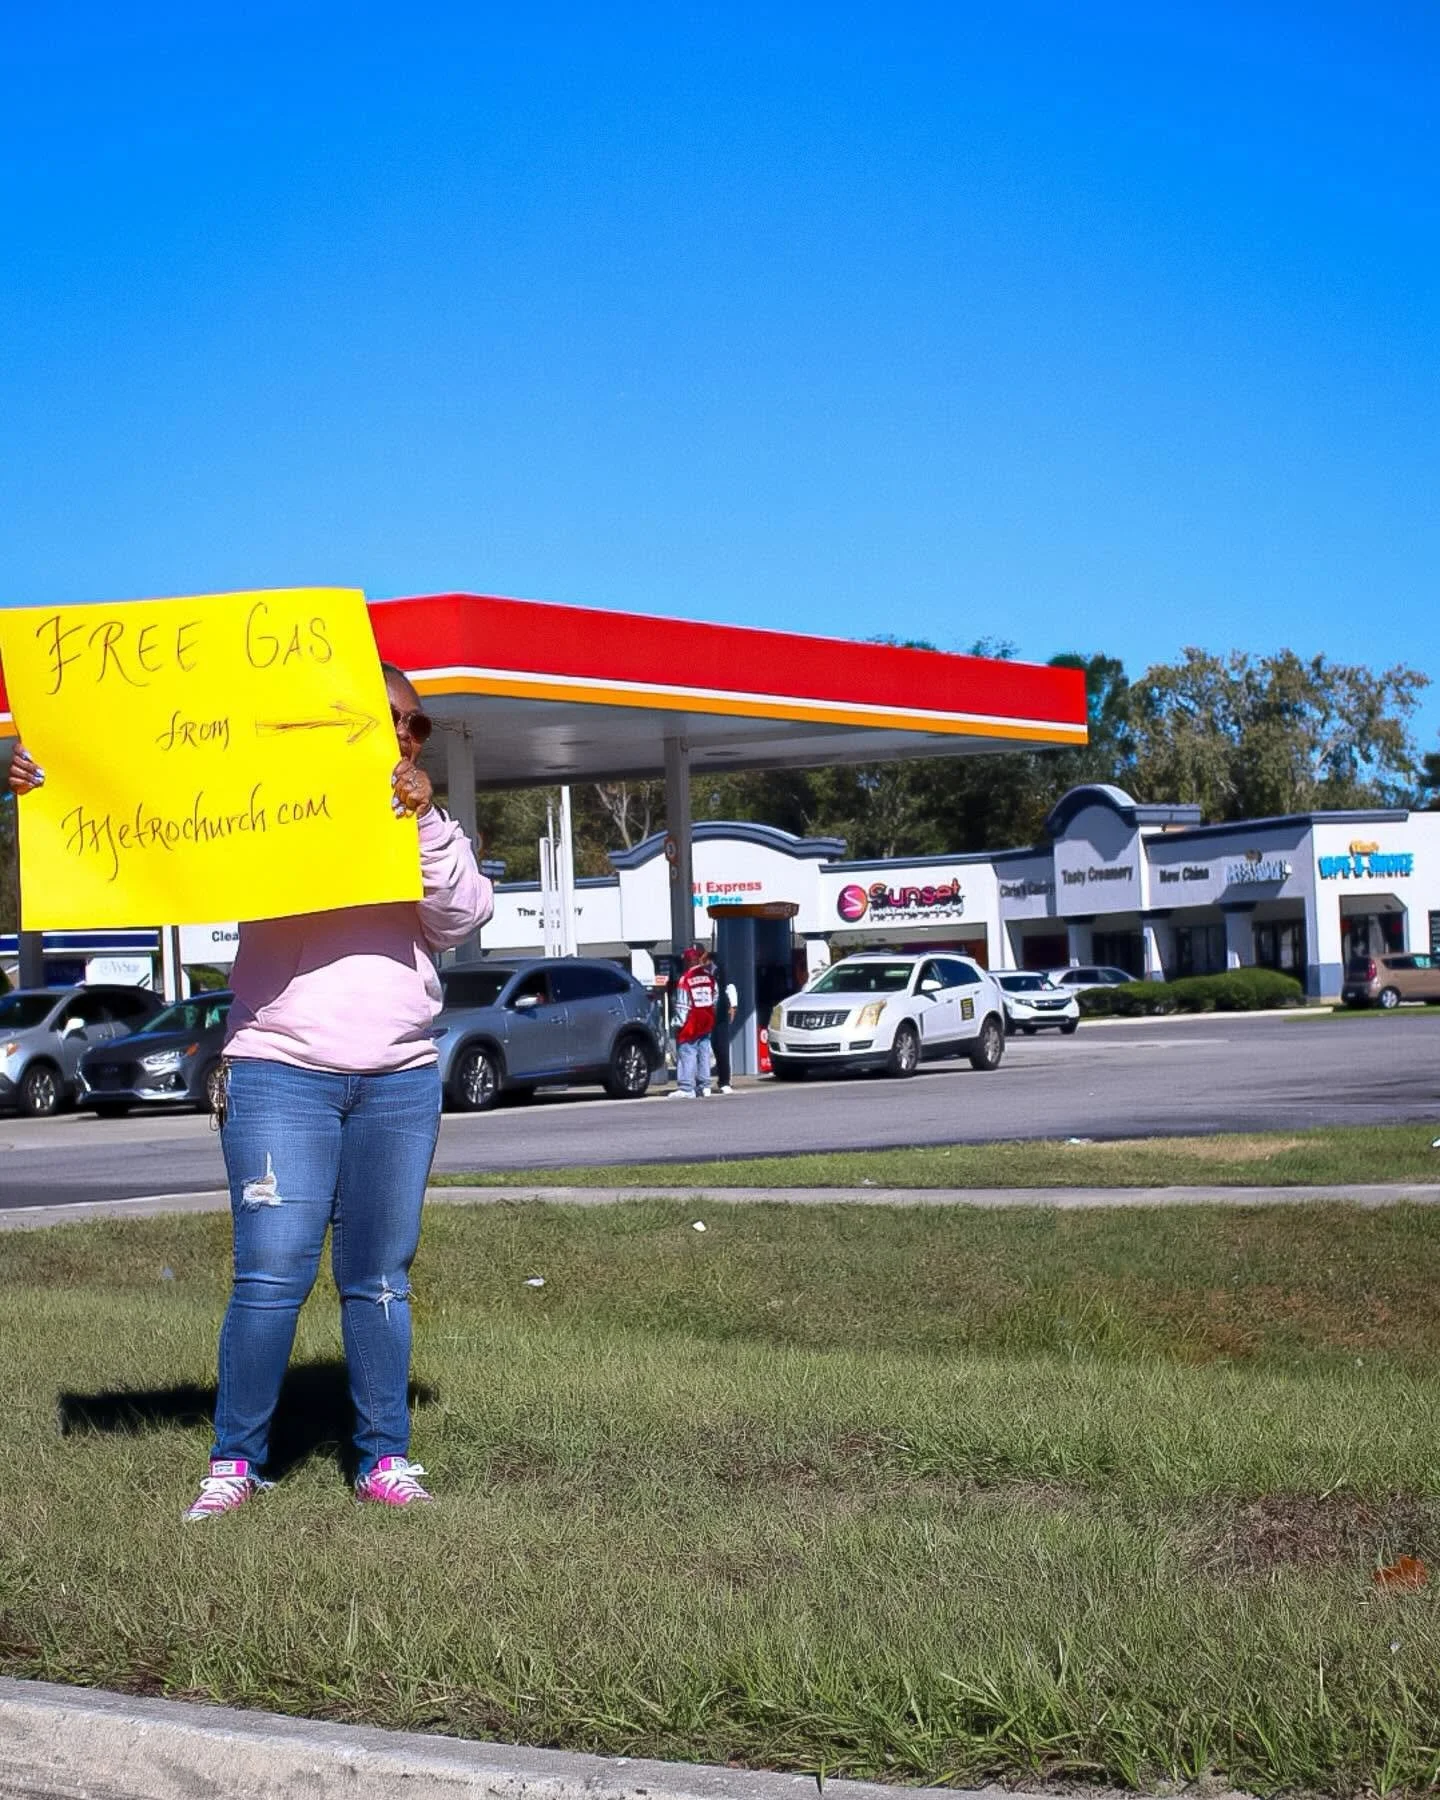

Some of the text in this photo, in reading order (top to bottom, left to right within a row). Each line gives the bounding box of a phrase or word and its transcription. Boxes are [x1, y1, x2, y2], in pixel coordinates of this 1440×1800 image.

[36, 615, 203, 695] FREE
[706, 880, 763, 895] Express
[868, 877, 963, 909] Sunset
[516, 907, 537, 917] The
